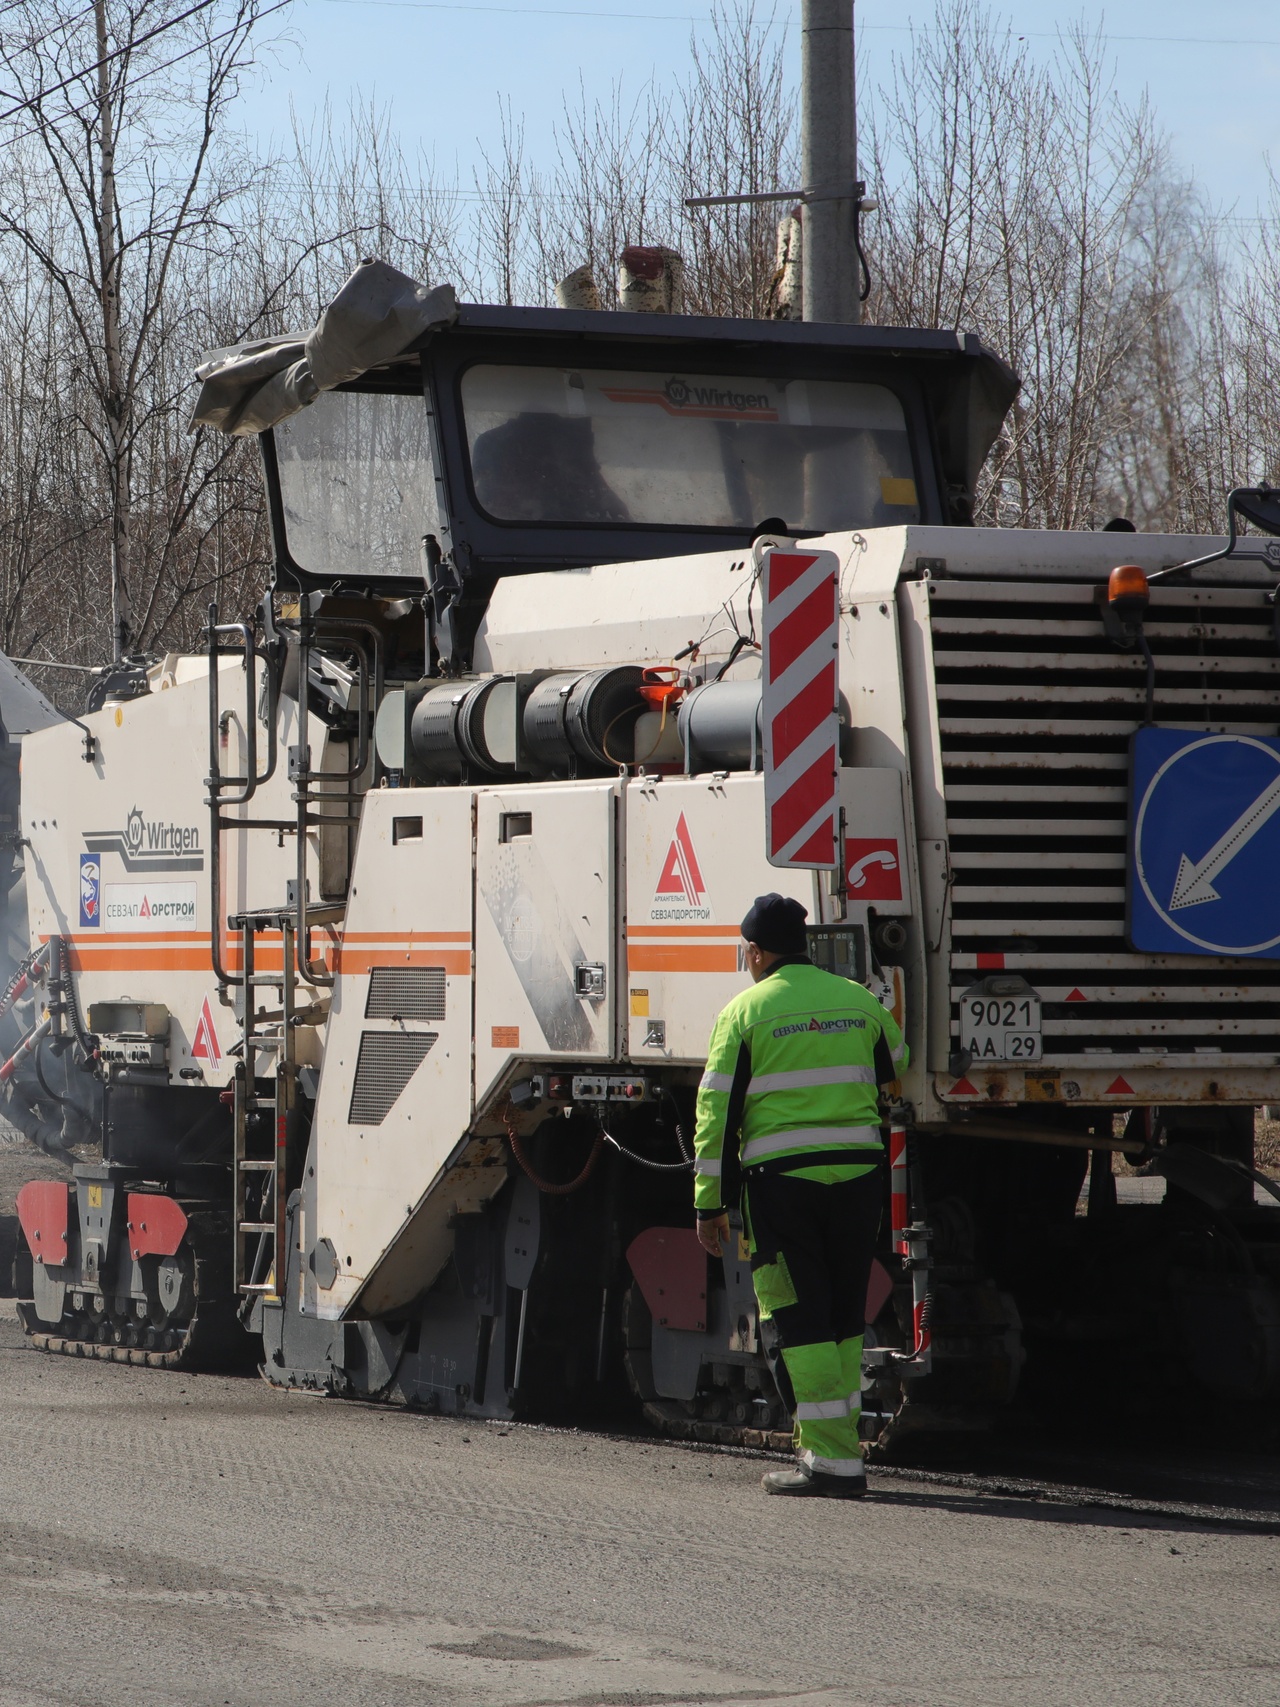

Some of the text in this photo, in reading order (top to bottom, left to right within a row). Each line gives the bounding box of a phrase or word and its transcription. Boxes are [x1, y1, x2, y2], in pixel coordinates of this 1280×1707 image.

[694, 388, 769, 411] Wirtgen
[147, 822, 199, 856] Wirtgen
[651, 908, 711, 921] СЕВЗАПДОРСТРОЙ
[970, 1001, 1031, 1027] 9021
[1011, 1038, 1036, 1057] 29
